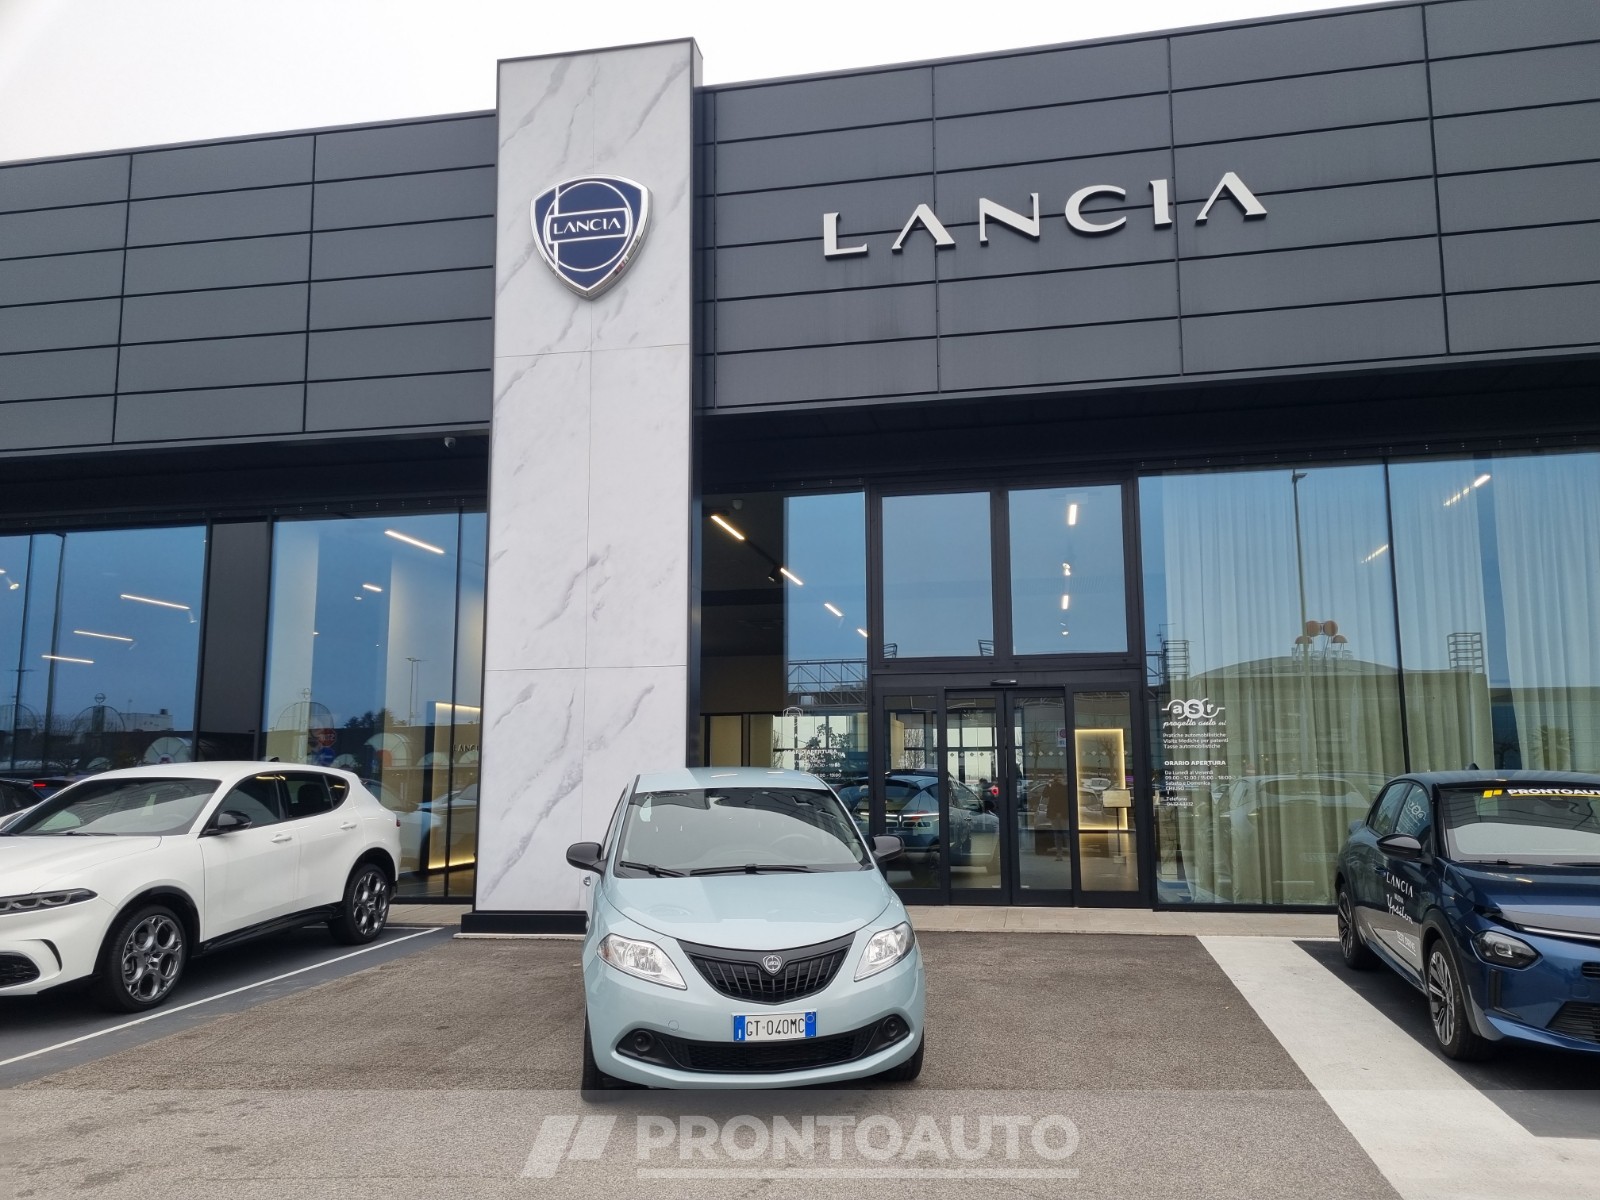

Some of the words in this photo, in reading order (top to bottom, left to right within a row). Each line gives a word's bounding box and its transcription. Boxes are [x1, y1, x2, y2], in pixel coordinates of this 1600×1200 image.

[553, 217, 621, 235] LANCIA
[823, 171, 1268, 260] LANCIA
[453, 744, 479, 752] LANCI
[1386, 872, 1414, 898] LANCIA
[1386, 893, 1413, 924] Ypsilon
